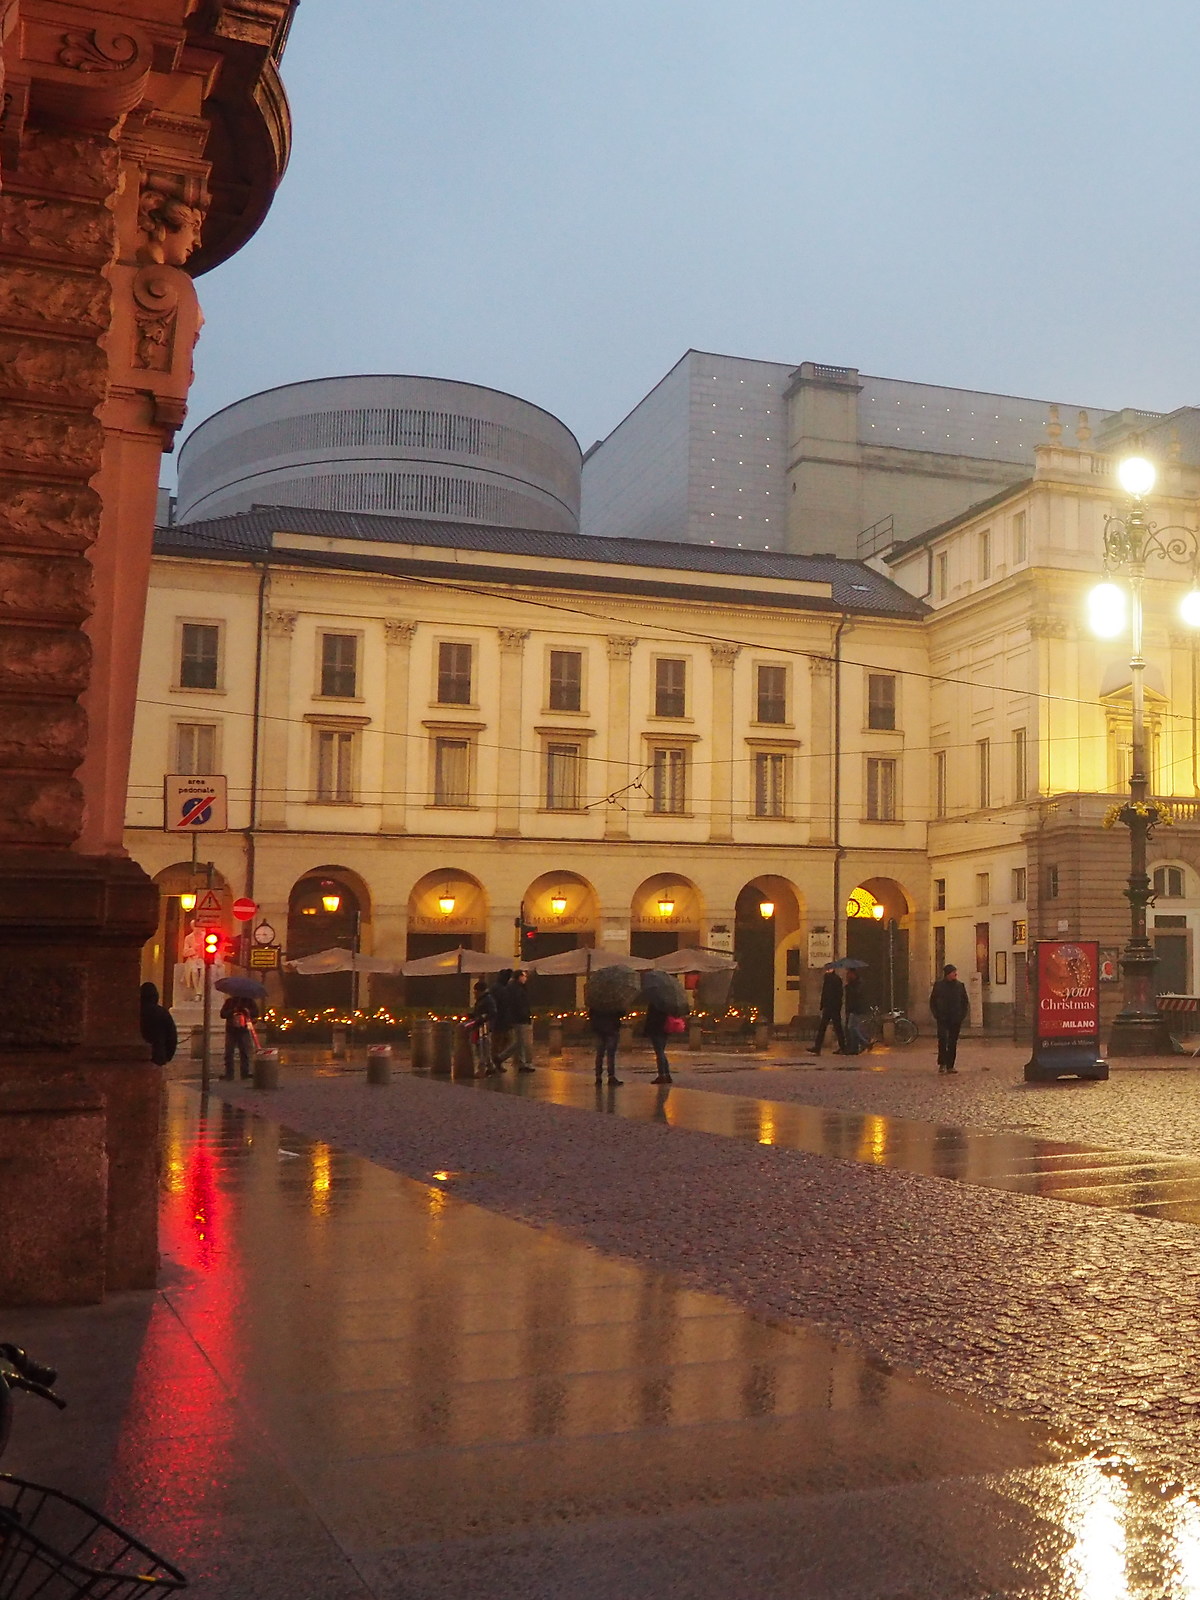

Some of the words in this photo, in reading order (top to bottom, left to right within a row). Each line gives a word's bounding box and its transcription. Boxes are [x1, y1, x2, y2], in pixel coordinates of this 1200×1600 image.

[1063, 987, 1095, 1001] your
[1040, 998, 1096, 1010] Christmas
[1062, 1020, 1095, 1028] MILANO
